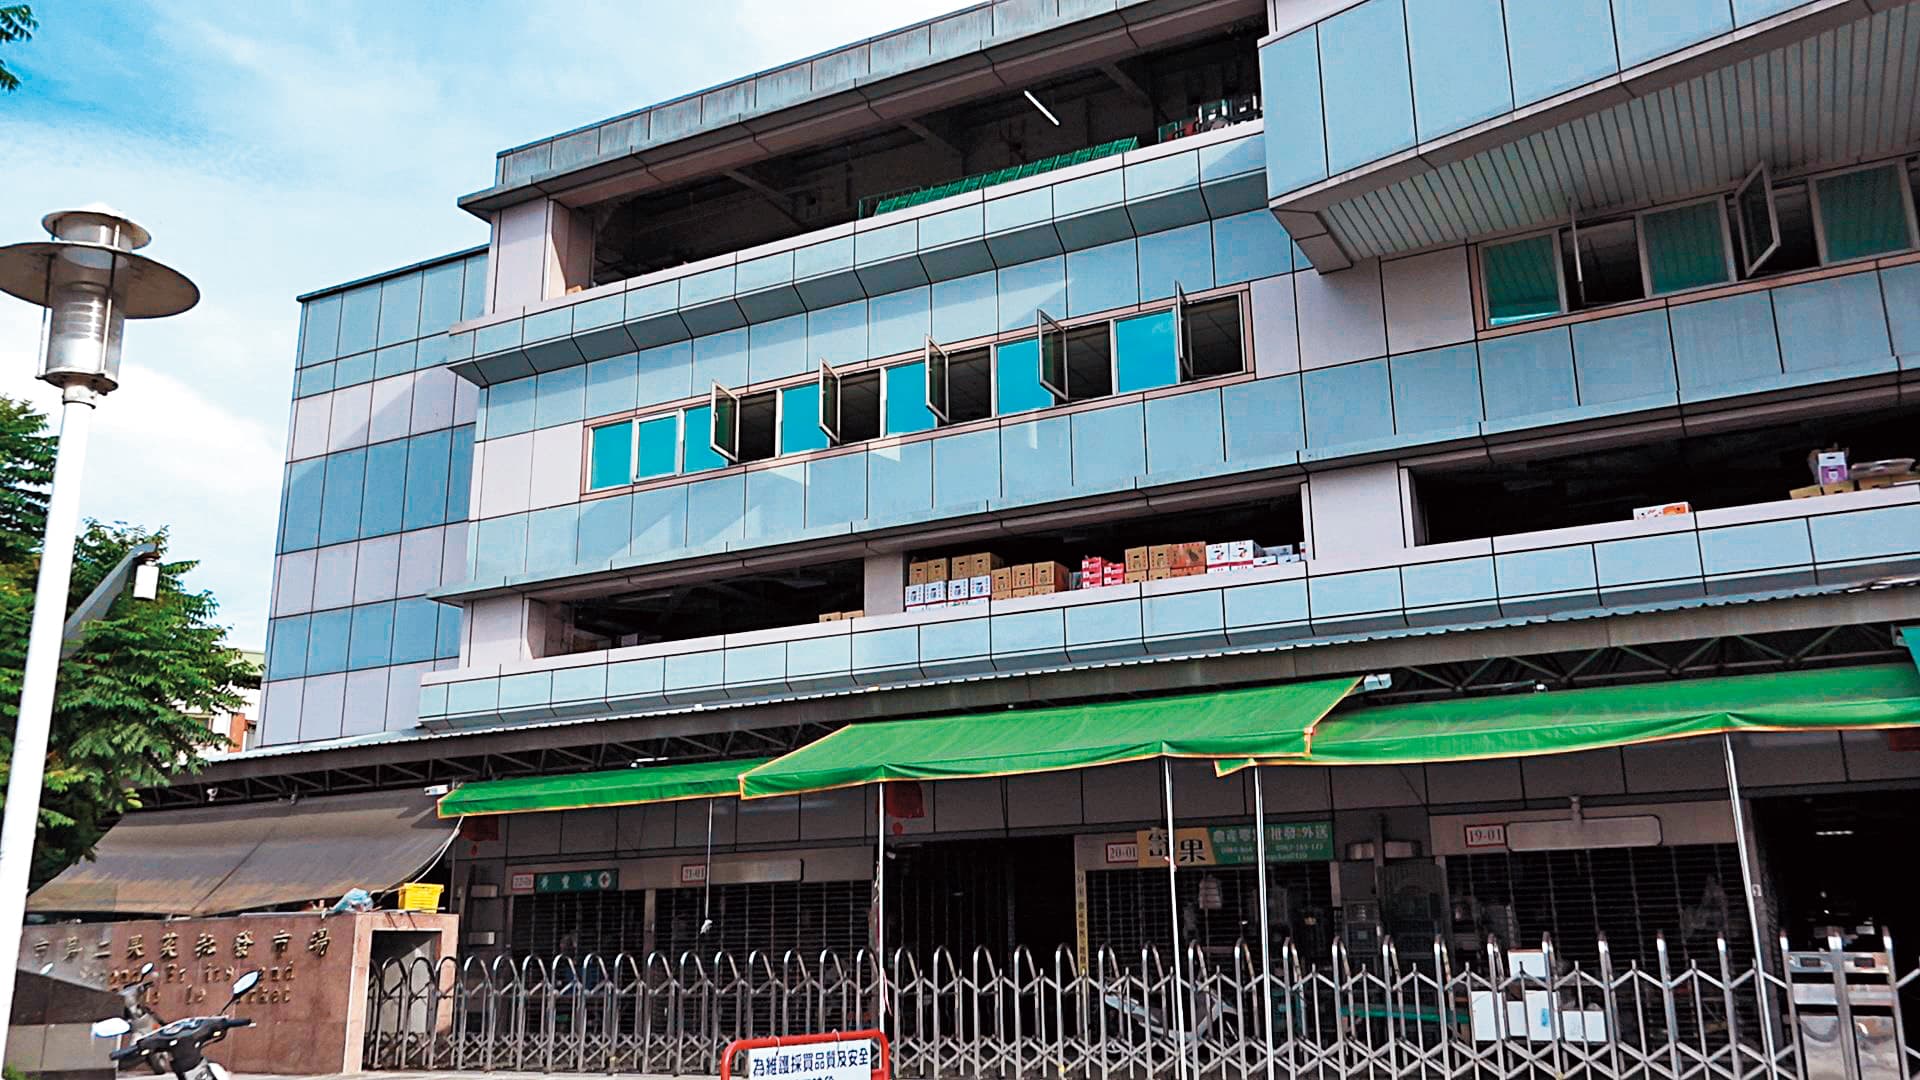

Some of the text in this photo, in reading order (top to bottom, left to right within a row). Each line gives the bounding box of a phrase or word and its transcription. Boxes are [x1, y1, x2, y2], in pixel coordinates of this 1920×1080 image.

[1468, 828, 1501, 842] 19-01
[1109, 846, 1136, 861] 20-01
[753, 1047, 868, 1077] 為維護採買品質及安全
